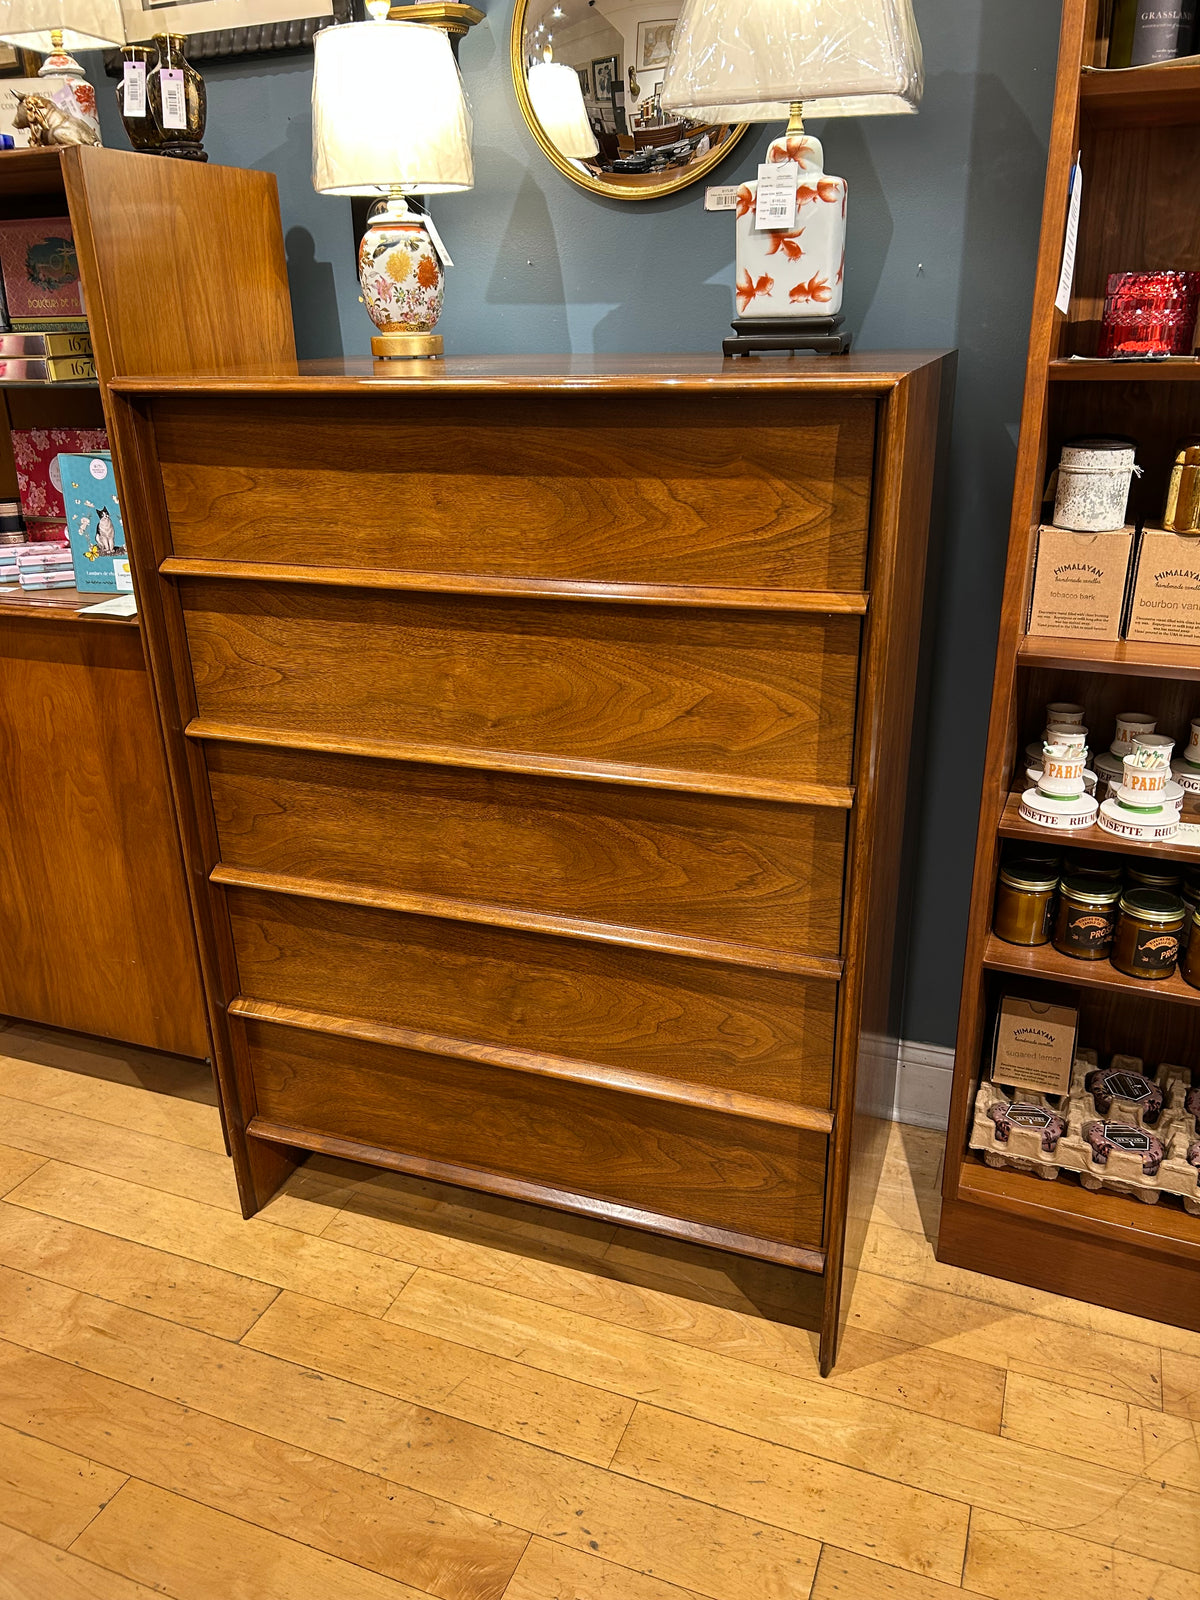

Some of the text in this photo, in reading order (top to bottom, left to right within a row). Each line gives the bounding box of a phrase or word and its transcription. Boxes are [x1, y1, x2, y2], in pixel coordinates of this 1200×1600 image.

[1054, 564, 1104, 577] HIMALAYAN
[1154, 570, 1200, 581] HIMALAYA
[1155, 582, 1183, 590] handmade
[1140, 598, 1179, 609] bourbon
[1048, 763, 1083, 779] PARIS
[1132, 776, 1166, 791] PARIS
[1178, 778, 1200, 791] COG
[1160, 944, 1178, 960] PROS
[1013, 1028, 1056, 1042] HIMALAYAN
[1006, 1050, 1062, 1062] sugared lemon
